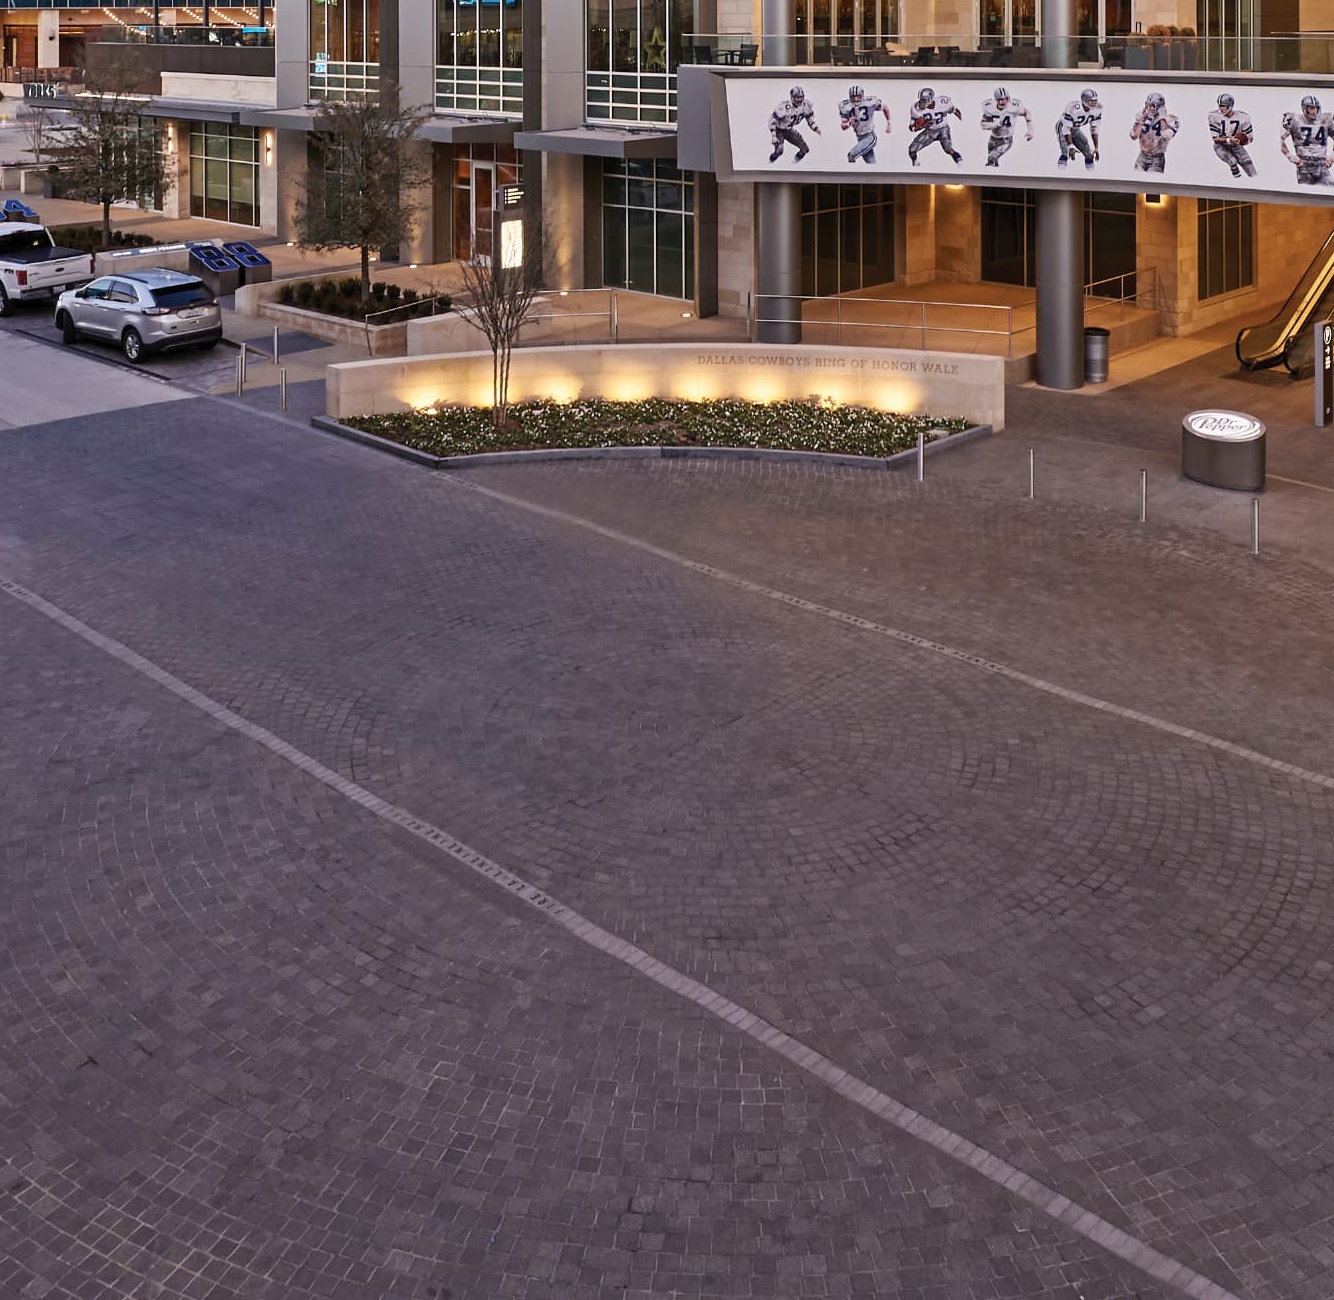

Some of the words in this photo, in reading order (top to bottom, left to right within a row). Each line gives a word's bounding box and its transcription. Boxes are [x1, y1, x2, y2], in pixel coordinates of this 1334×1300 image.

[1218, 120, 1240, 135] 17
[1299, 126, 1329, 146] 74
[190, 241, 272, 272] 88
[698, 355, 744, 365] DALLAS
[748, 356, 811, 366] COWBOYS
[815, 358, 846, 368] RING
[850, 359, 868, 369] OF
[872, 360, 917, 372] HONOR
[920, 363, 960, 375] WALK
[1198, 416, 1244, 432] Pepper
